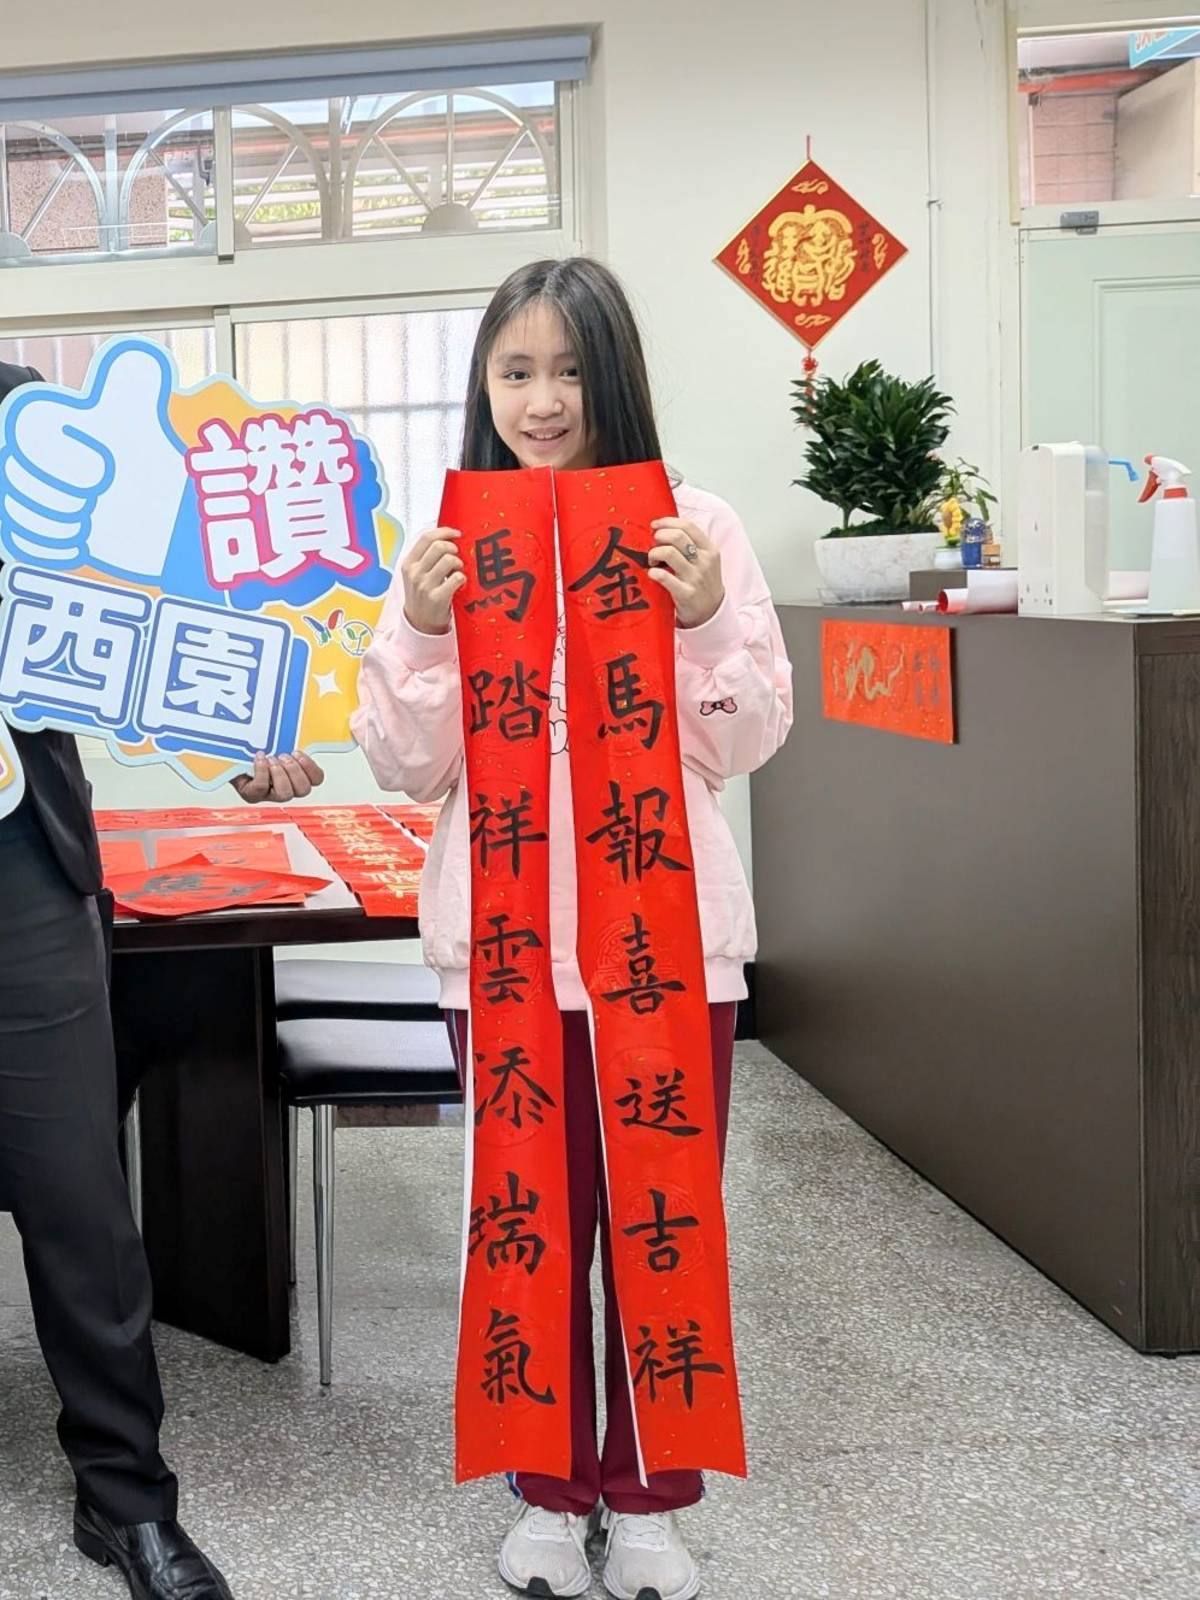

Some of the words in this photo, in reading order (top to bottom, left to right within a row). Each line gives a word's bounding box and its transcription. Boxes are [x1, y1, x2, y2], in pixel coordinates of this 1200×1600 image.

[189, 413, 367, 585] 讚
[464, 528, 557, 1406] 馬踏祥雲添瑞氣
[569, 526, 725, 1410] 金馬報喜送吉祥
